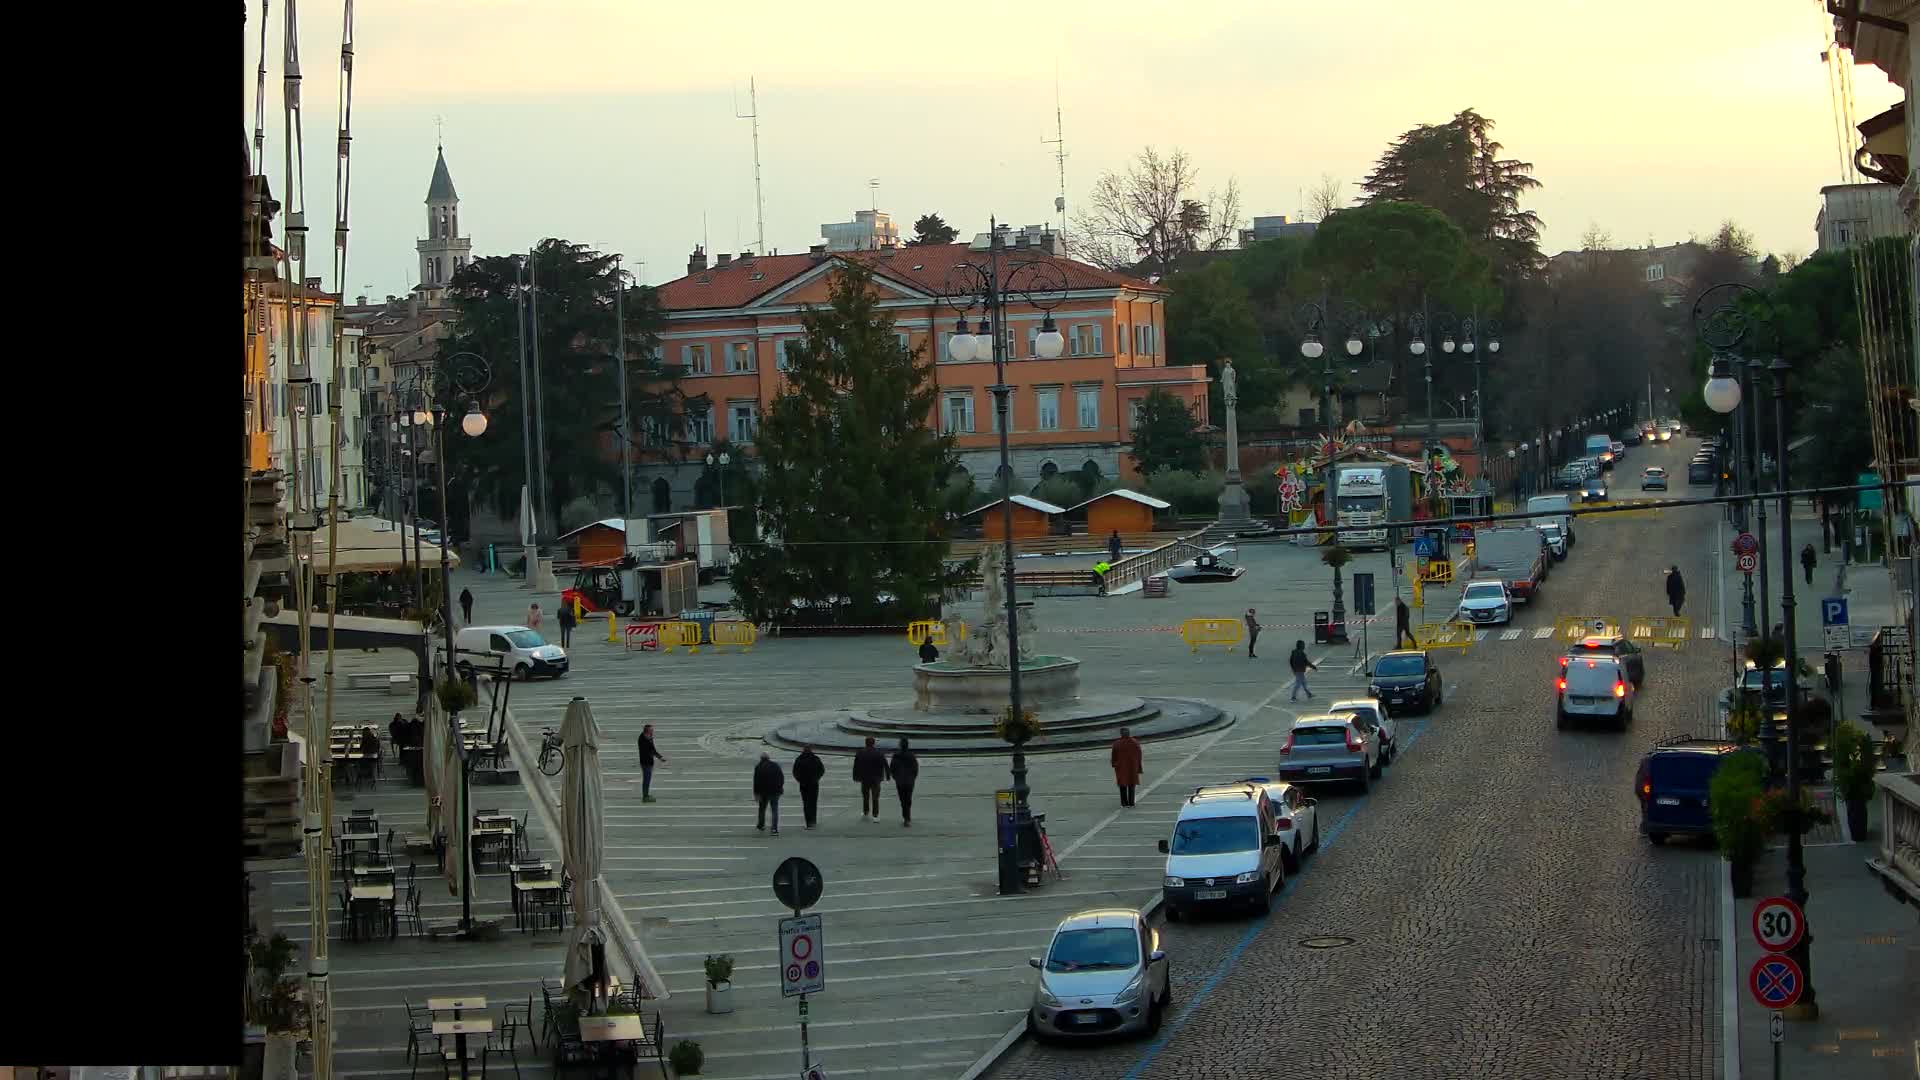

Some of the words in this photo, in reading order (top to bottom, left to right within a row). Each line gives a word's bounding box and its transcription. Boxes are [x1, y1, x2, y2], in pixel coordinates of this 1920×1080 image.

[1742, 557, 1752, 567] 20
[1828, 602, 1842, 622] P
[1762, 911, 1791, 938] 30
